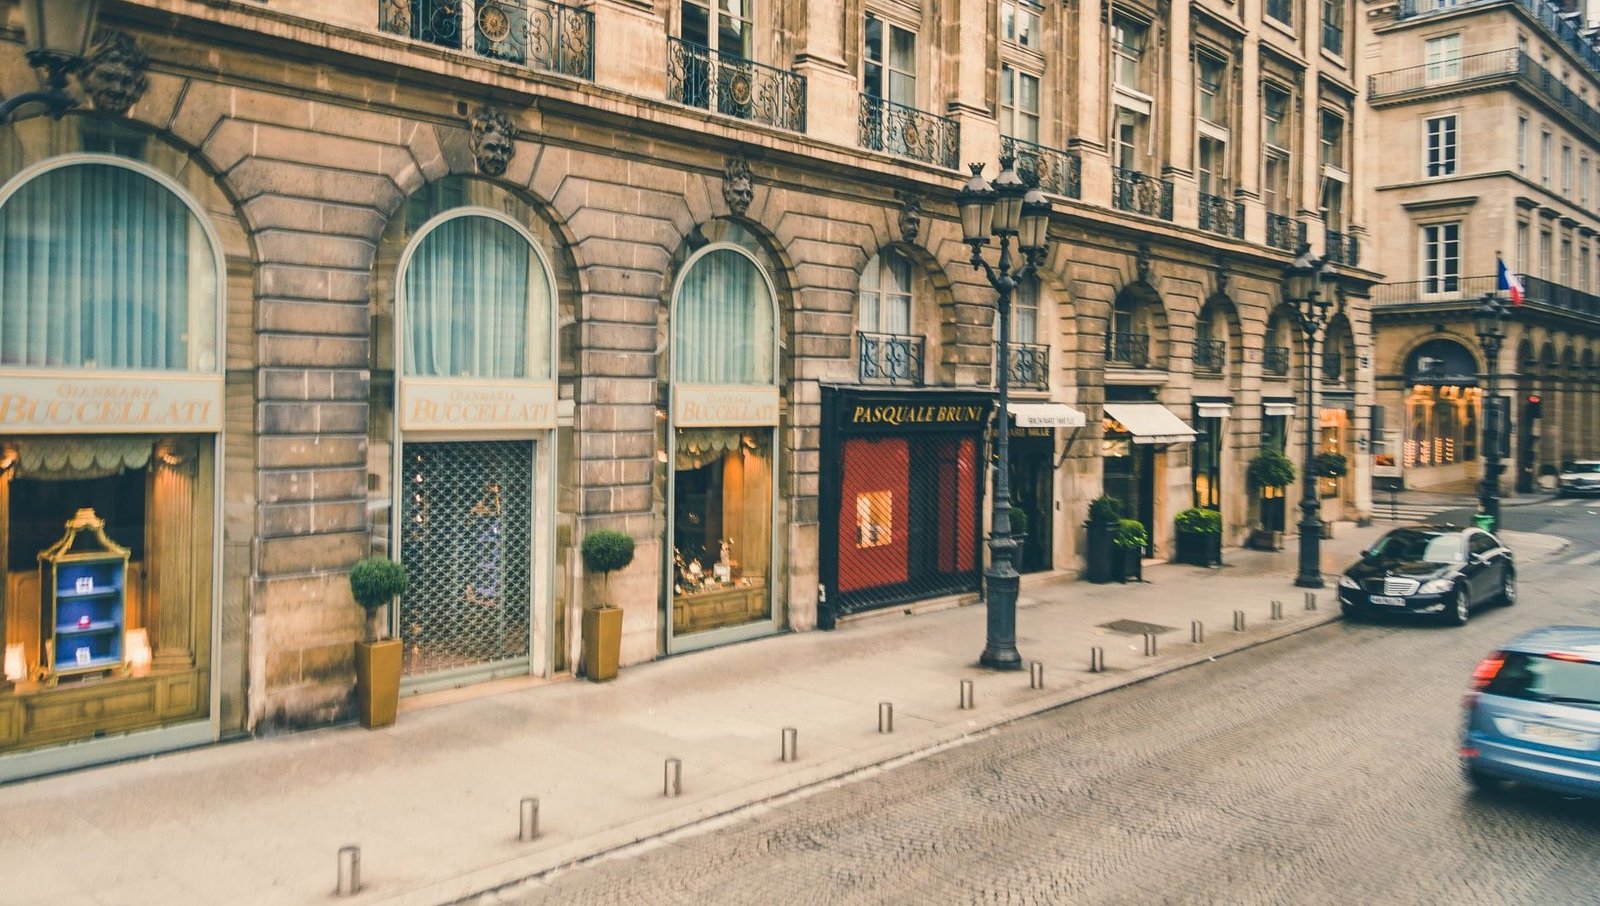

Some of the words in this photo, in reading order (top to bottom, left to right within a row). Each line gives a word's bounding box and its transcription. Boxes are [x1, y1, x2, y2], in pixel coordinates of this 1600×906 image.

[56, 383, 159, 399] GIANMARIA
[0, 392, 210, 425] BUCCELLATI
[412, 398, 549, 423] BUCCELLATI
[853, 406, 936, 425] PASQUALE
[937, 406, 983, 421] BRUNI
